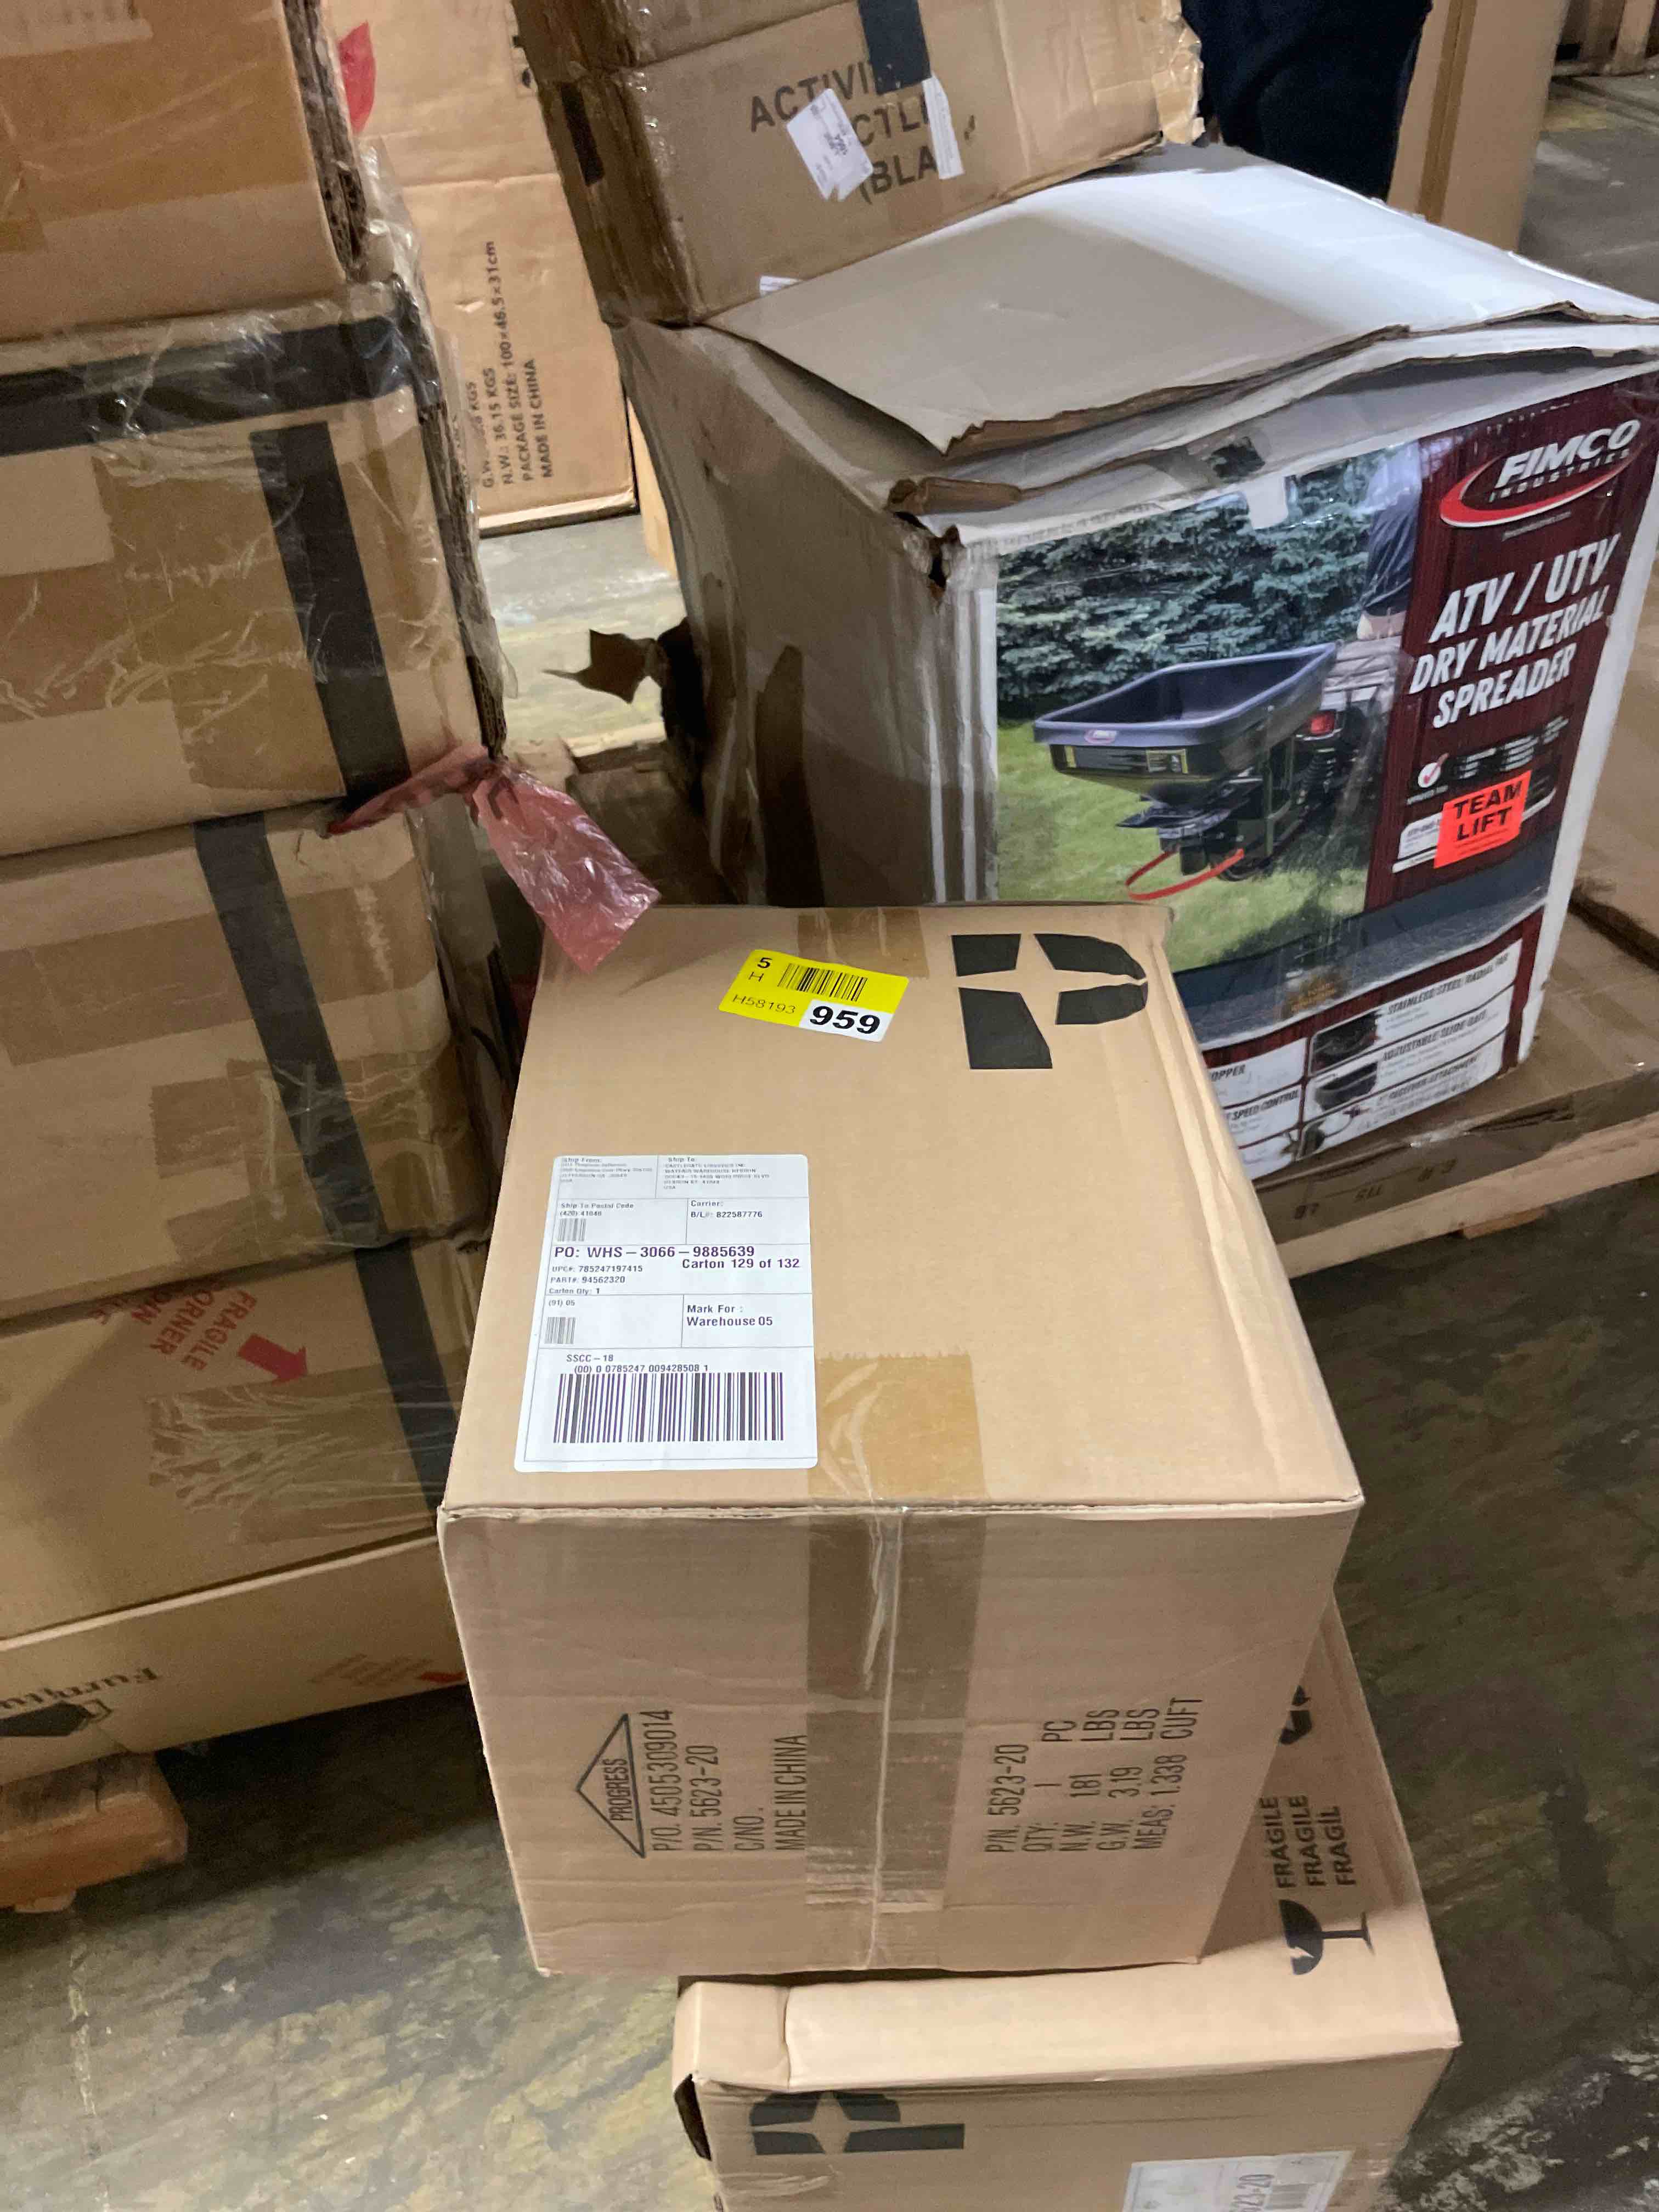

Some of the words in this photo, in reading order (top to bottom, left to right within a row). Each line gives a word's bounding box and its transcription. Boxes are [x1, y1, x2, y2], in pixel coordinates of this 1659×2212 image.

[483, 368, 498, 398] KGS
[524, 359, 543, 409] CHINA
[532, 413, 545, 430] IN
[510, 414, 534, 482] PACKAGE
[535, 435, 553, 478] MADE
[1494, 419, 1641, 489] FIMCO
[1488, 448, 1630, 503] INDUSTRIES
[1428, 571, 1515, 644] ATV
[1512, 561, 1544, 616] /
[1544, 532, 1621, 604] UTV
[1408, 637, 1479, 695] DRY
[1478, 584, 1610, 671] MATERIAL
[1432, 642, 1577, 730] SPREADER
[1453, 780, 1523, 820] TEAM
[1456, 806, 1513, 842] LIFT
[748, 970, 765, 982] H
[757, 957, 772, 969] 5
[732, 994, 796, 1014] H58193
[809, 1005, 881, 1035] 959
[1211, 1064, 1246, 1082] OPPER
[554, 1246, 580, 1258] PO:
[682, 1259, 725, 1268] Carton
[731, 1259, 754, 1268] 129
[759, 1259, 772, 1268] of
[777, 1259, 800, 1268] 132
[549, 1299, 563, 1307] (91)
[686, 1316, 755, 1327] Warehouse
[758, 1316, 773, 1327] 05
[687, 1305, 713, 1313] Mark
[181, 1290, 257, 1371] FRAGILE
[574, 1365, 592, 1374] (00)
[596, 1365, 602, 1373] 0
[605, 1365, 645, 1373] 0785247
[648, 1364, 700, 1373] 009428508
[1041, 1720, 1077, 1742] PC
[1080, 1709, 1120, 1742] LBS
[1119, 1708, 1160, 1741] LBS
[1159, 1697, 1204, 1740] CUFT
[639, 1709, 682, 1817] 4505309014
[774, 1734, 808, 1785] CHINA
[1150, 1754, 1187, 1796] 1.338
[602, 1757, 634, 1821] PROGRESS
[684, 1745, 724, 1818] 5623-20
[774, 1790, 806, 1804] IN
[987, 1743, 1029, 1816] 5623-20
[650, 1823, 682, 1852] P/O.
[692, 1822, 725, 1852] P/N.
[774, 1809, 806, 1850] MADE
[984, 1825, 1021, 1853] P/N.
[1260, 1797, 1296, 1889] FRAGILE
[1289, 1795, 1326, 1887] FRAGILE
[1318, 1805, 1357, 1886] FRAGIL
